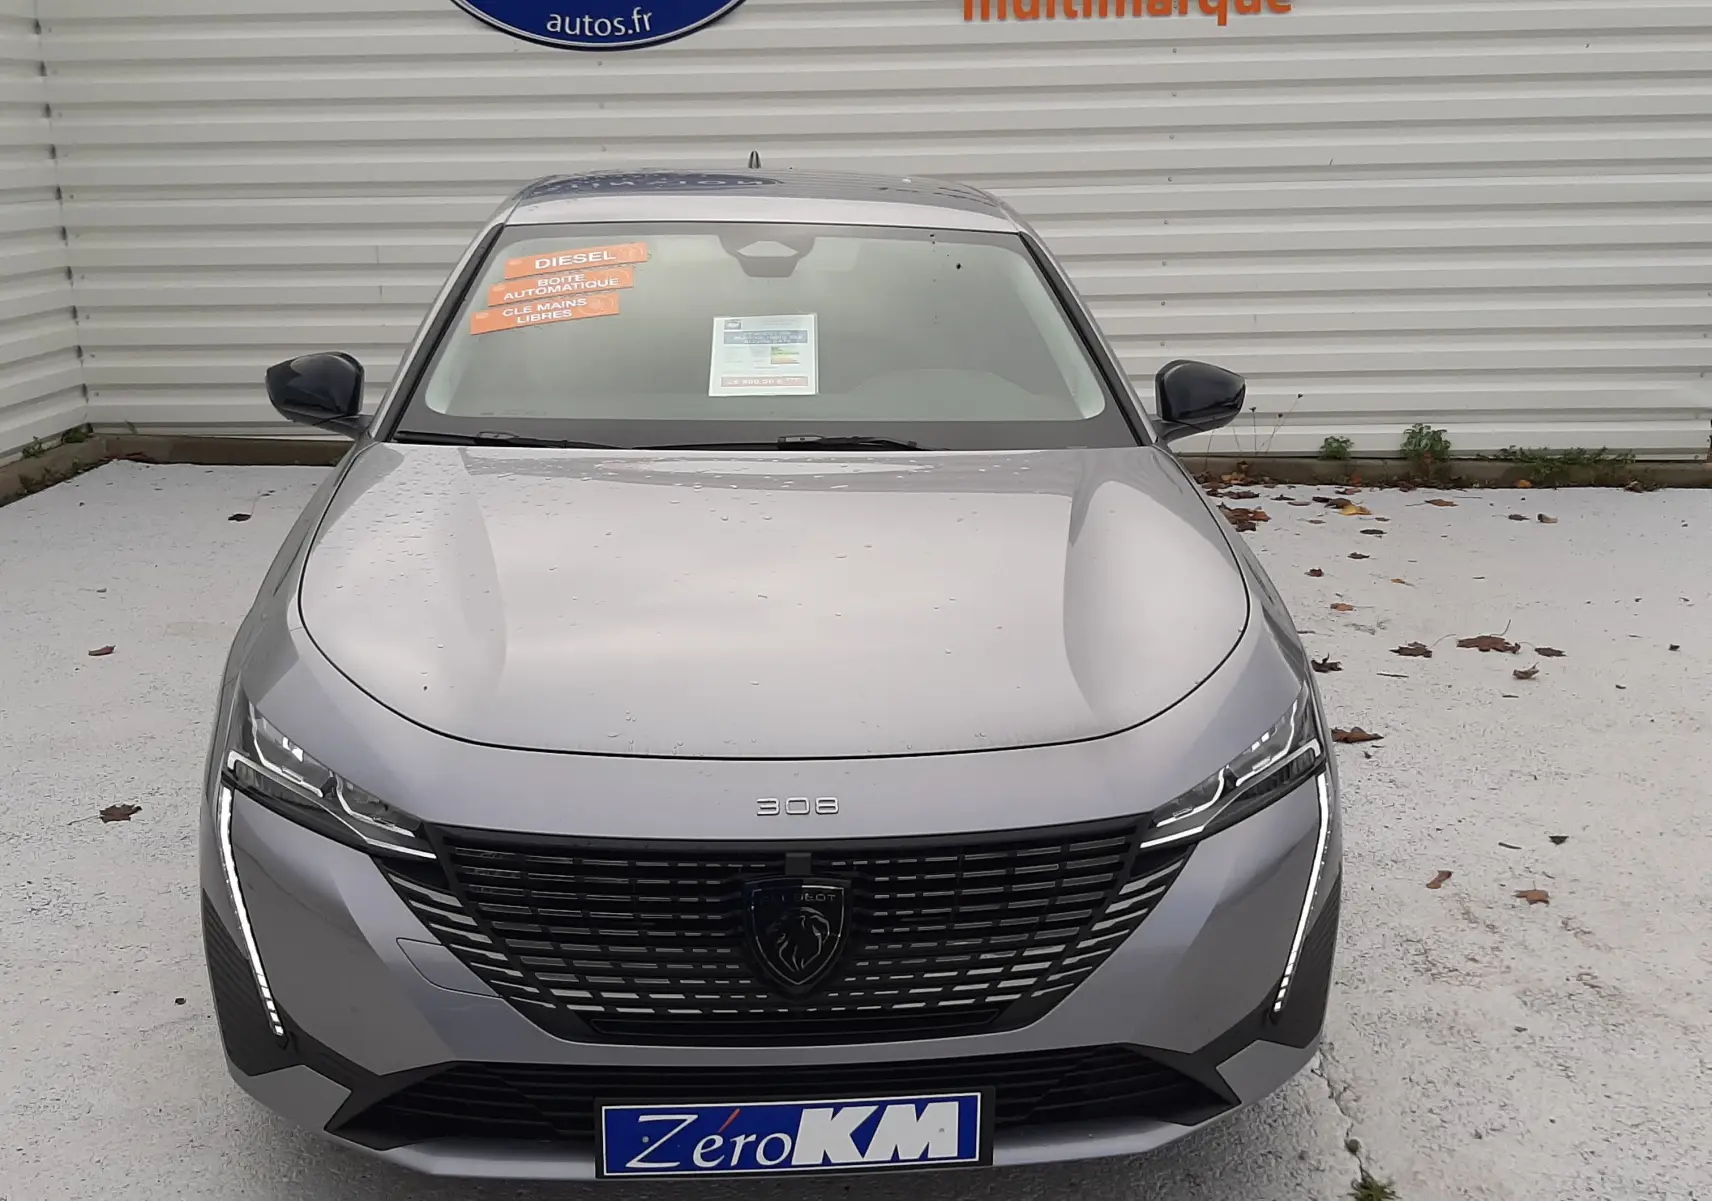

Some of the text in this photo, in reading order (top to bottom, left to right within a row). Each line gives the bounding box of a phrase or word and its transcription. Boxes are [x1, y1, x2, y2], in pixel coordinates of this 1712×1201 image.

[546, 7, 653, 36] autos.fr
[535, 250, 616, 269] DIESEL
[503, 278, 620, 300] AUTOMATIQUE
[537, 274, 585, 287] BOITE
[502, 298, 587, 317] CLE MAINS
[517, 309, 573, 324] LIBRES
[756, 797, 839, 816] 308
[759, 892, 837, 903] UGEOT
